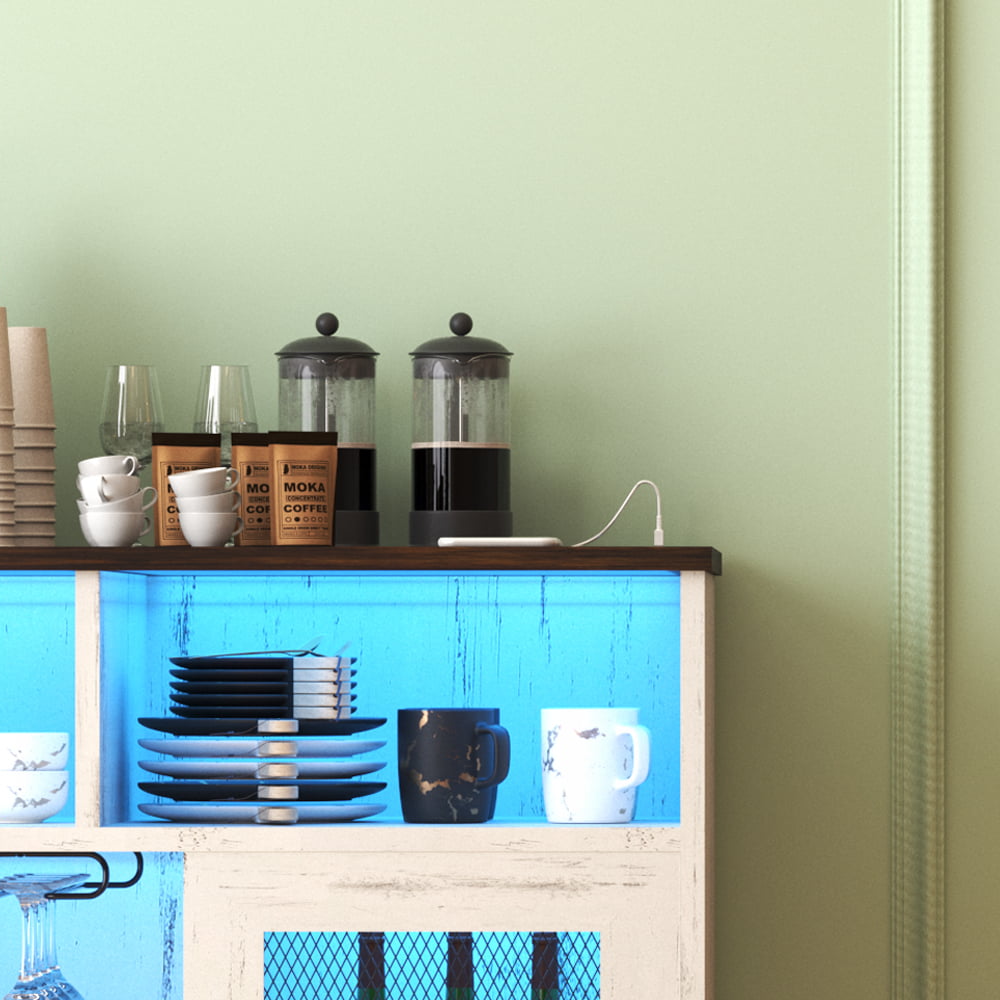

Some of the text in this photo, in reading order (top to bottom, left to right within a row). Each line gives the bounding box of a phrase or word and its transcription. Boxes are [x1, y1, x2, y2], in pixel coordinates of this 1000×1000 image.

[246, 483, 269, 493] MO
[283, 482, 326, 492] MOKA
[246, 504, 270, 514] COF
[283, 504, 328, 513] COFFEE
